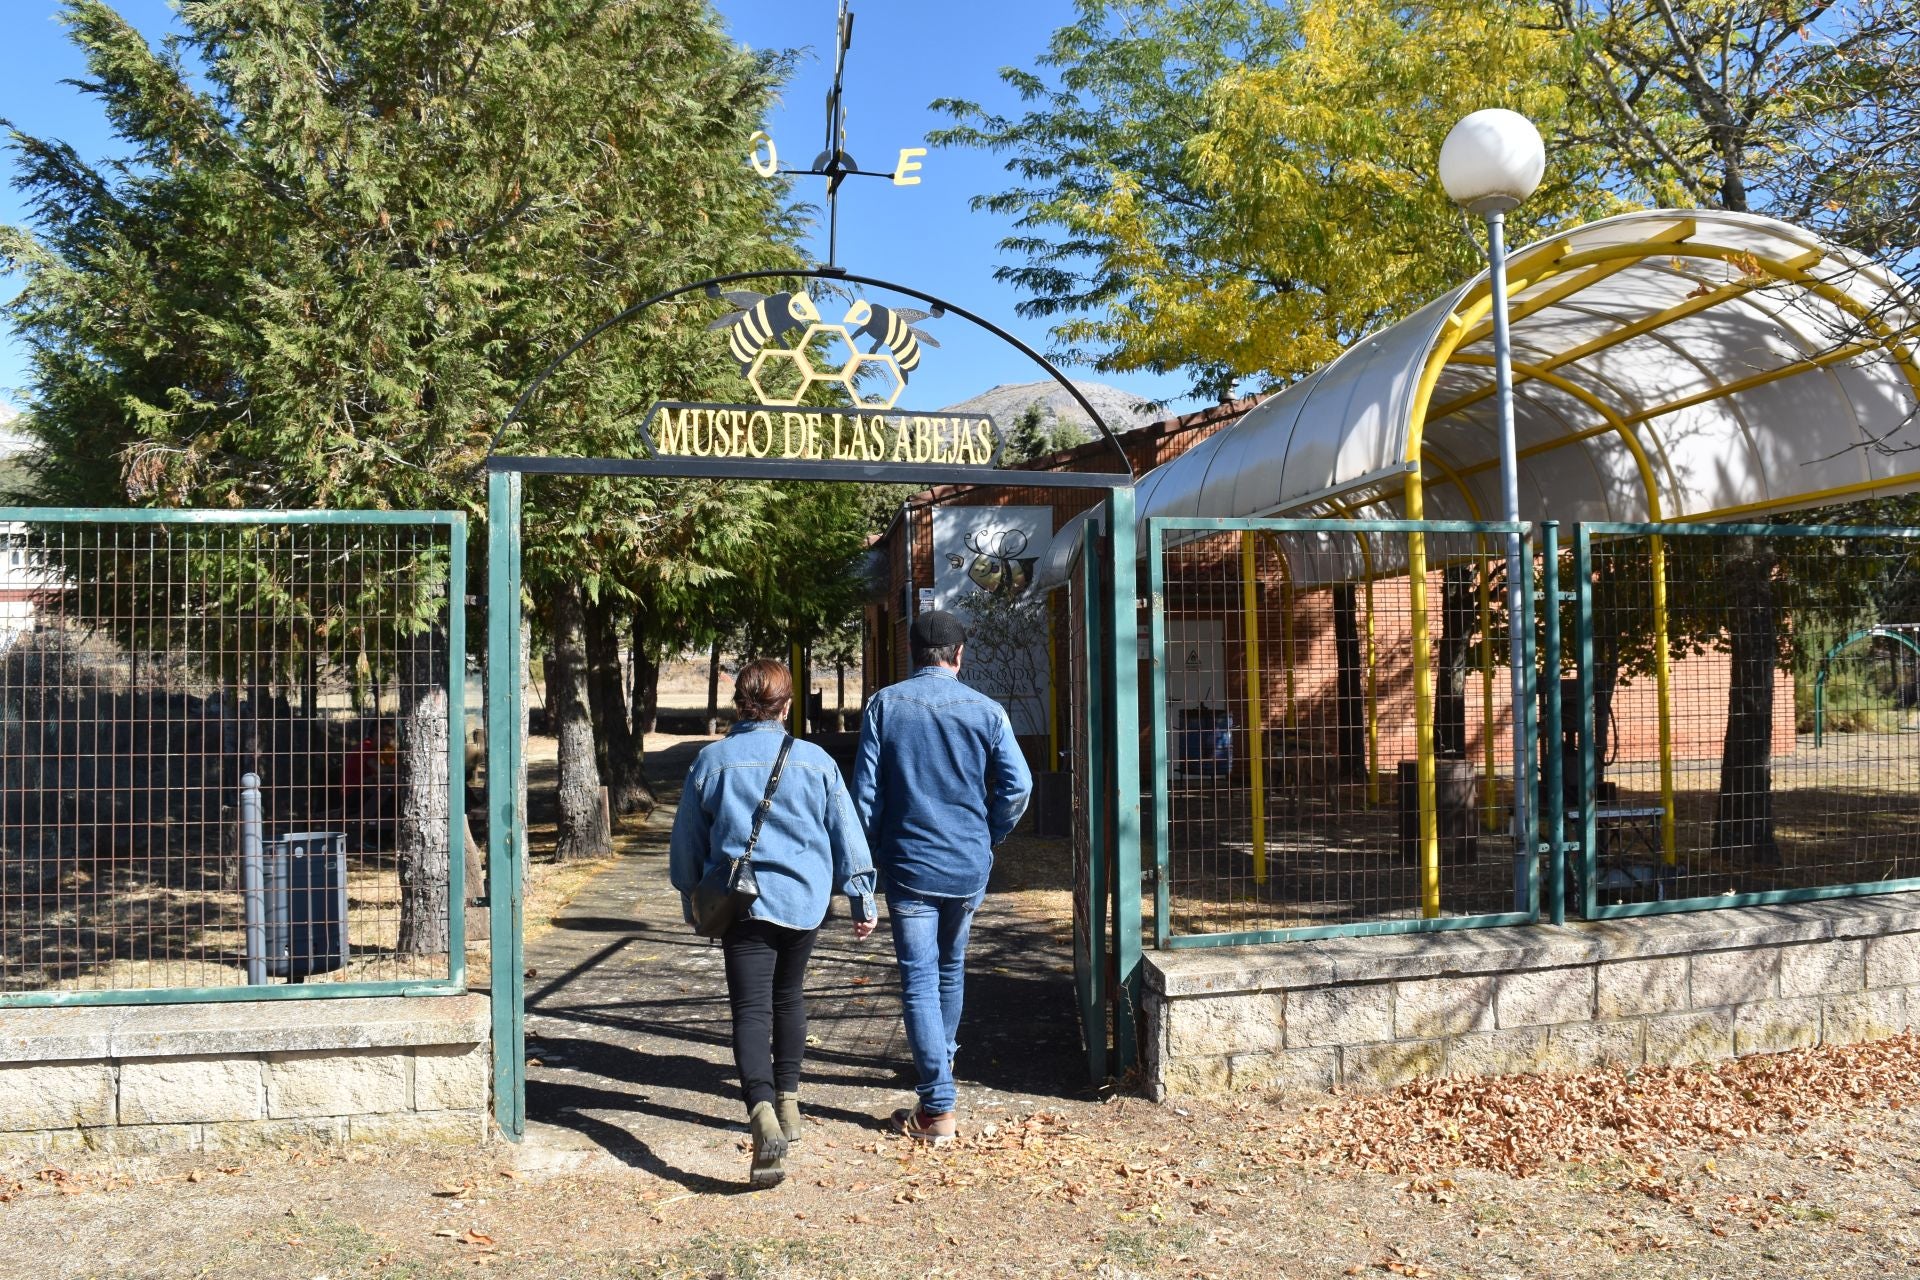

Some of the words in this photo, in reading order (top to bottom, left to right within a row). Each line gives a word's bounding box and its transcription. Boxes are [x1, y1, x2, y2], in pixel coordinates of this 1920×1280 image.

[749, 131, 777, 177] O
[893, 148, 927, 186] E
[657, 407, 773, 458] MUSEO
[782, 412, 824, 460] DE
[833, 413, 886, 462] LAS
[893, 416, 992, 465] ABEJAS
